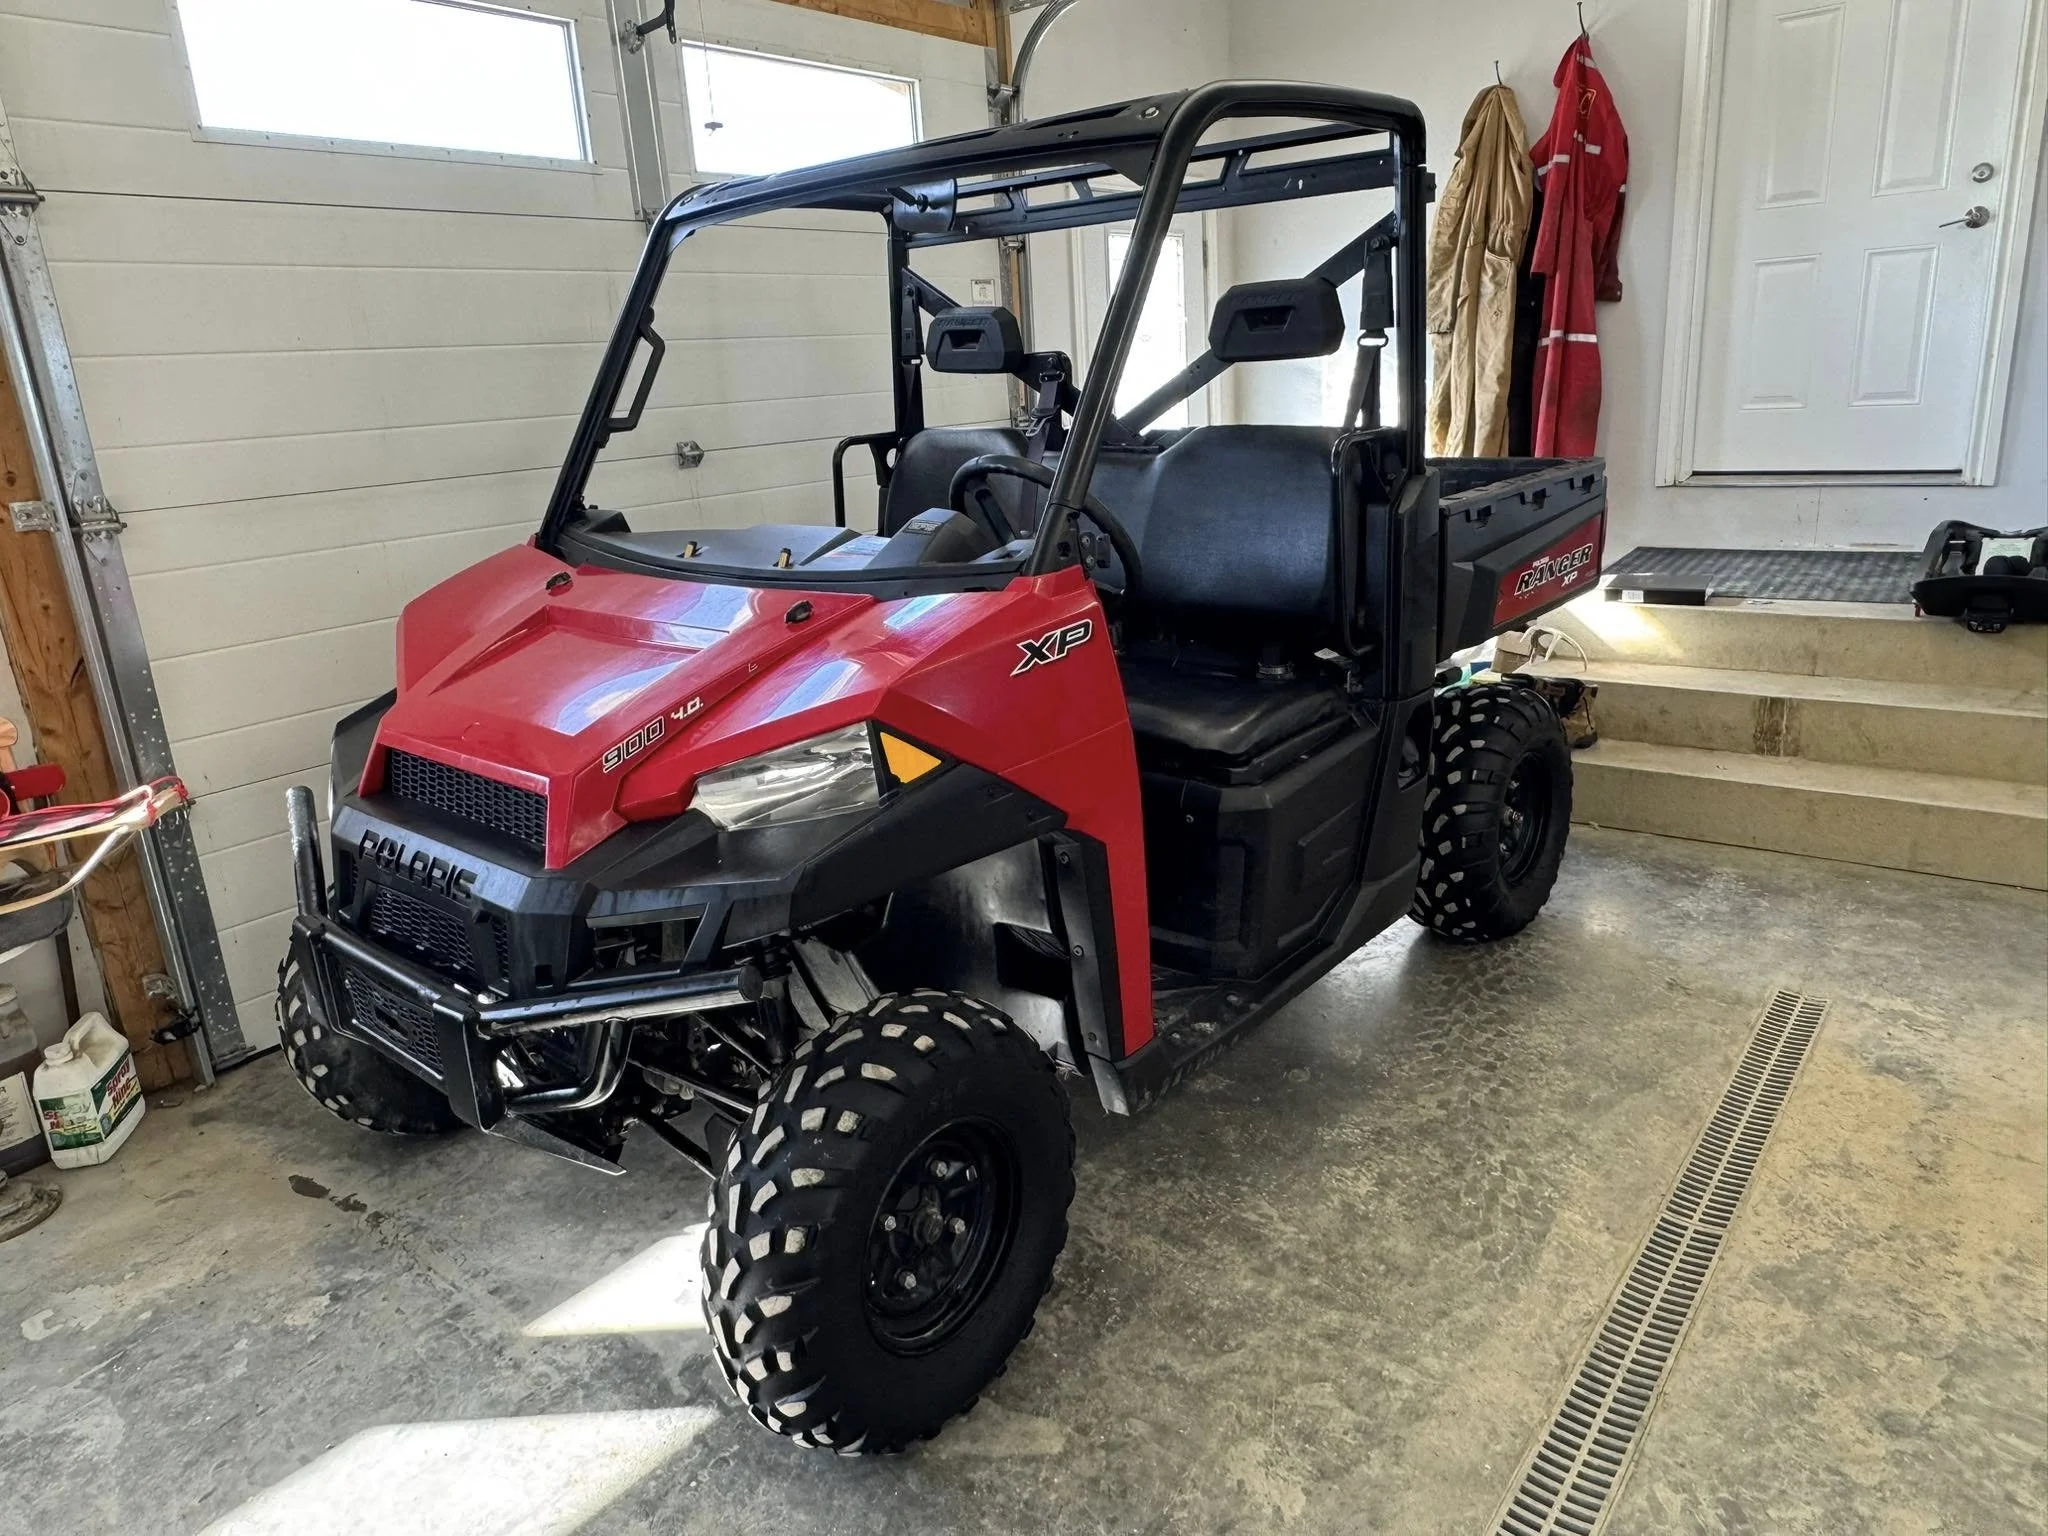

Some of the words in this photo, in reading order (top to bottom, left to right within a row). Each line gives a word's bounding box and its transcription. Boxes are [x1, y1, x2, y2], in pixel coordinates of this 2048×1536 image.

[1514, 543, 1593, 596] RANGER
[1561, 571, 1578, 587] XP
[1010, 618, 1093, 677] XP
[602, 715, 665, 774] 900
[359, 829, 477, 899] POLARIS
[106, 1061, 130, 1096] Spray
